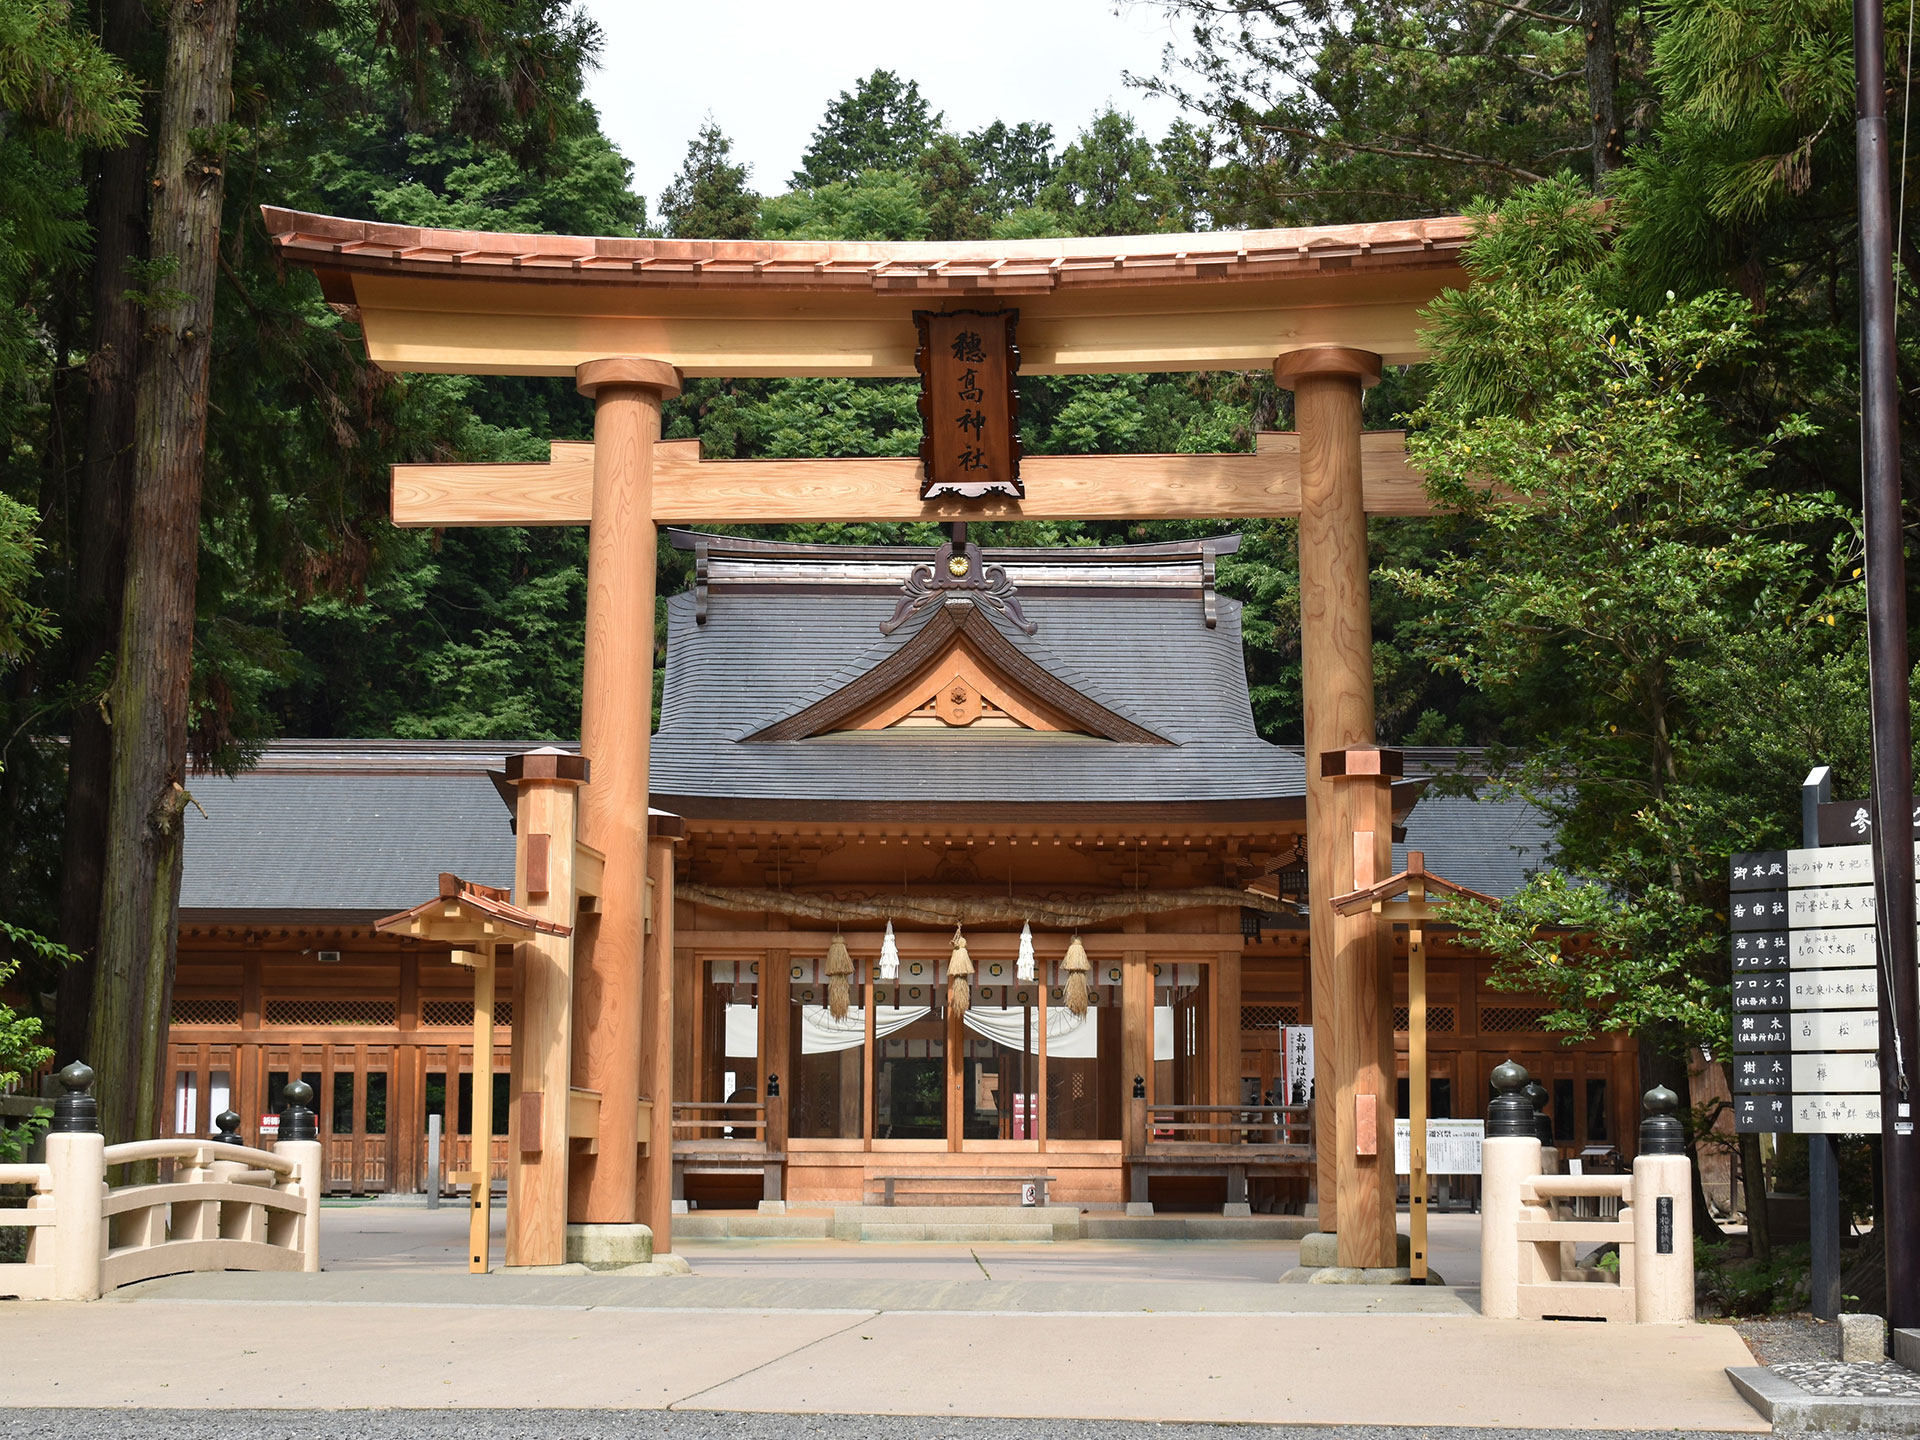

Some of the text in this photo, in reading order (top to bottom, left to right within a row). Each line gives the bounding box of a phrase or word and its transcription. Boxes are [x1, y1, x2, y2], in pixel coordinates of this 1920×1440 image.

[1733, 863, 1784, 880] 御本殿
[1733, 902, 1784, 918] 若宮社
[1736, 937, 1786, 949] 若宮社
[1736, 956, 1787, 967] ブロンズ
[1735, 978, 1785, 989] ブロンズ
